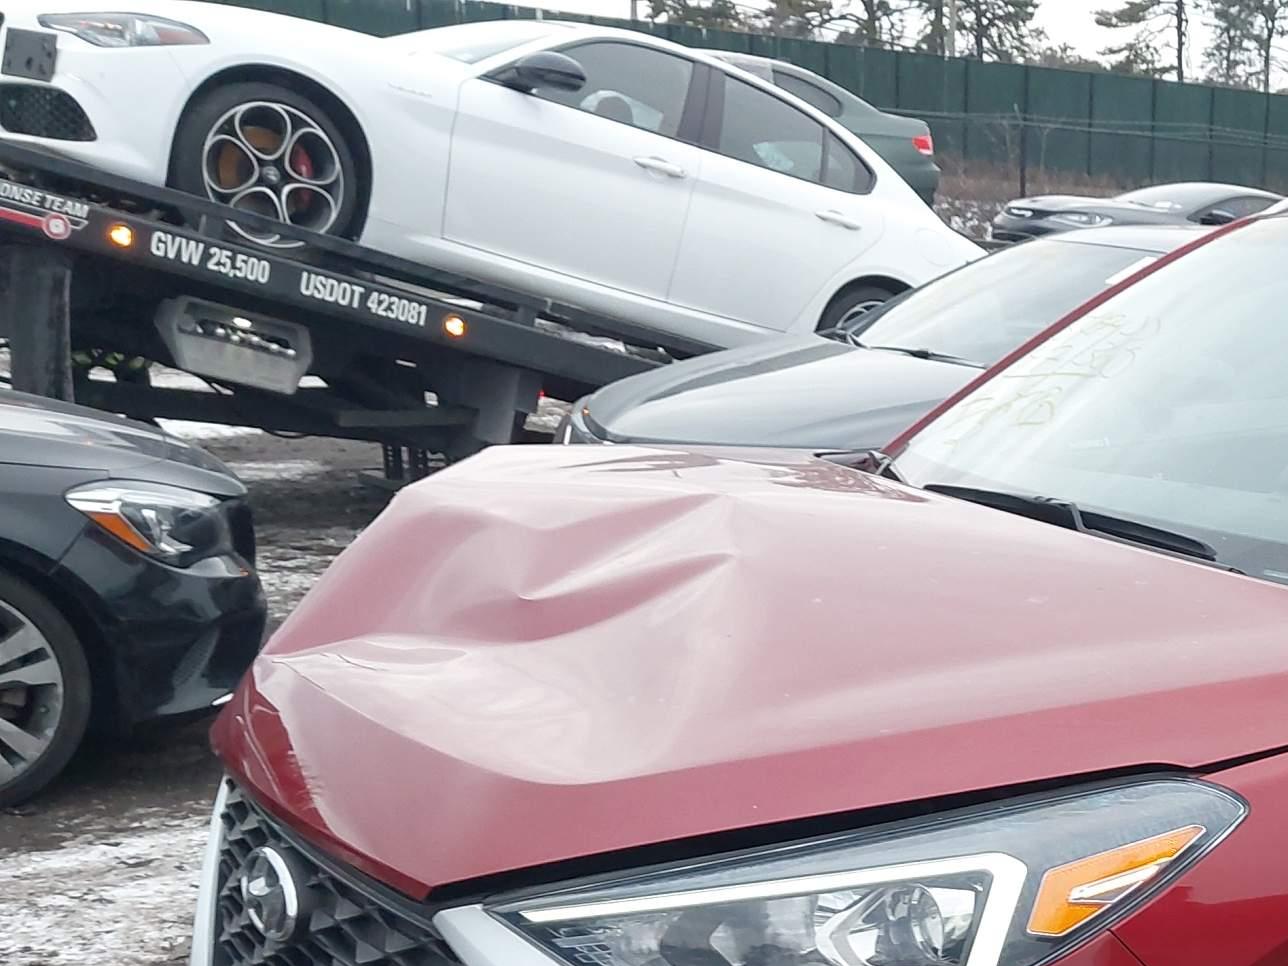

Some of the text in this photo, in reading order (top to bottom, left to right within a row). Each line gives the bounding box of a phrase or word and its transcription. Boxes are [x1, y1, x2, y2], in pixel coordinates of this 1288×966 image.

[44, 194, 89, 218] TEAM
[151, 230, 427, 327] GVW 25,500 USDOT 423081
